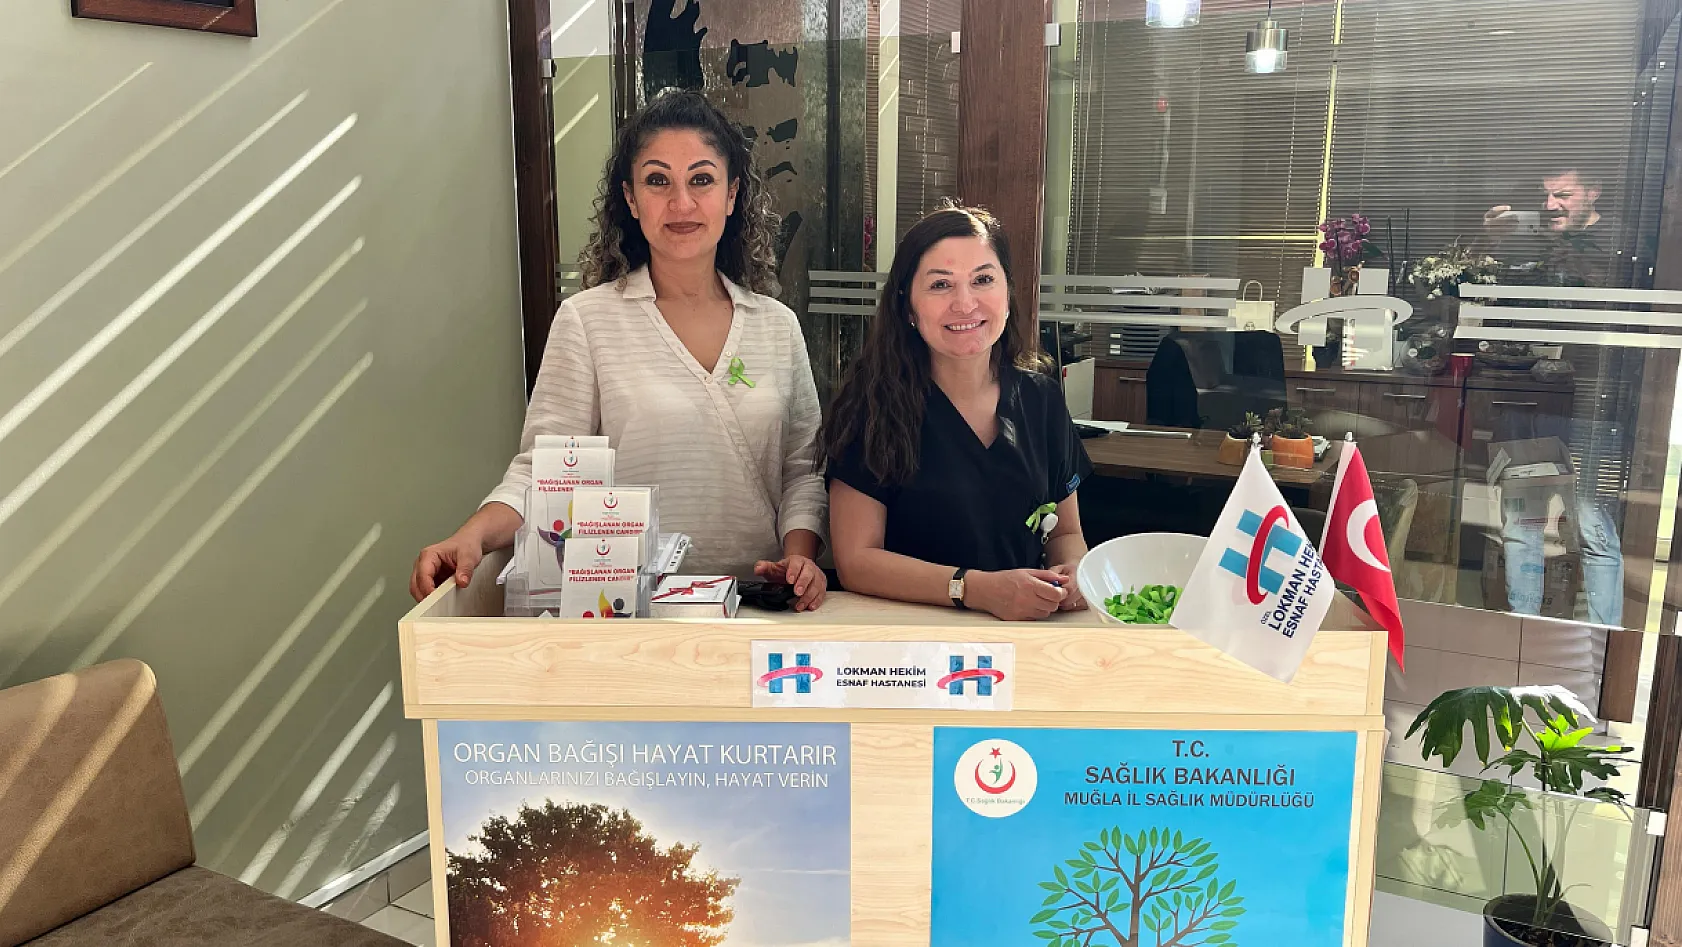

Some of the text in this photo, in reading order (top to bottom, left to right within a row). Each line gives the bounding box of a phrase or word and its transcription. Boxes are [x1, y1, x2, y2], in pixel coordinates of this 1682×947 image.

[1268, 568, 1306, 632] LOKMAN
[1283, 597, 1309, 638] ESNAF
[836, 665, 927, 677] LOKMAN HEKİM
[836, 678, 927, 689] ESNAF HASTANESİ
[453, 739, 838, 768] ORGAN BAĞIŞI HAYAT KURTARIR
[1171, 739, 1210, 758] T.C.
[465, 769, 829, 791] ORGANLARINIZI BAĞIŞLAYIN, HAYAT VERİN
[1084, 761, 1296, 787] SAĞLIK BAKANLIĞI
[1064, 788, 1315, 809] MUĞLA İL SAĞLIK MÜDÜRLÜĞÜ
